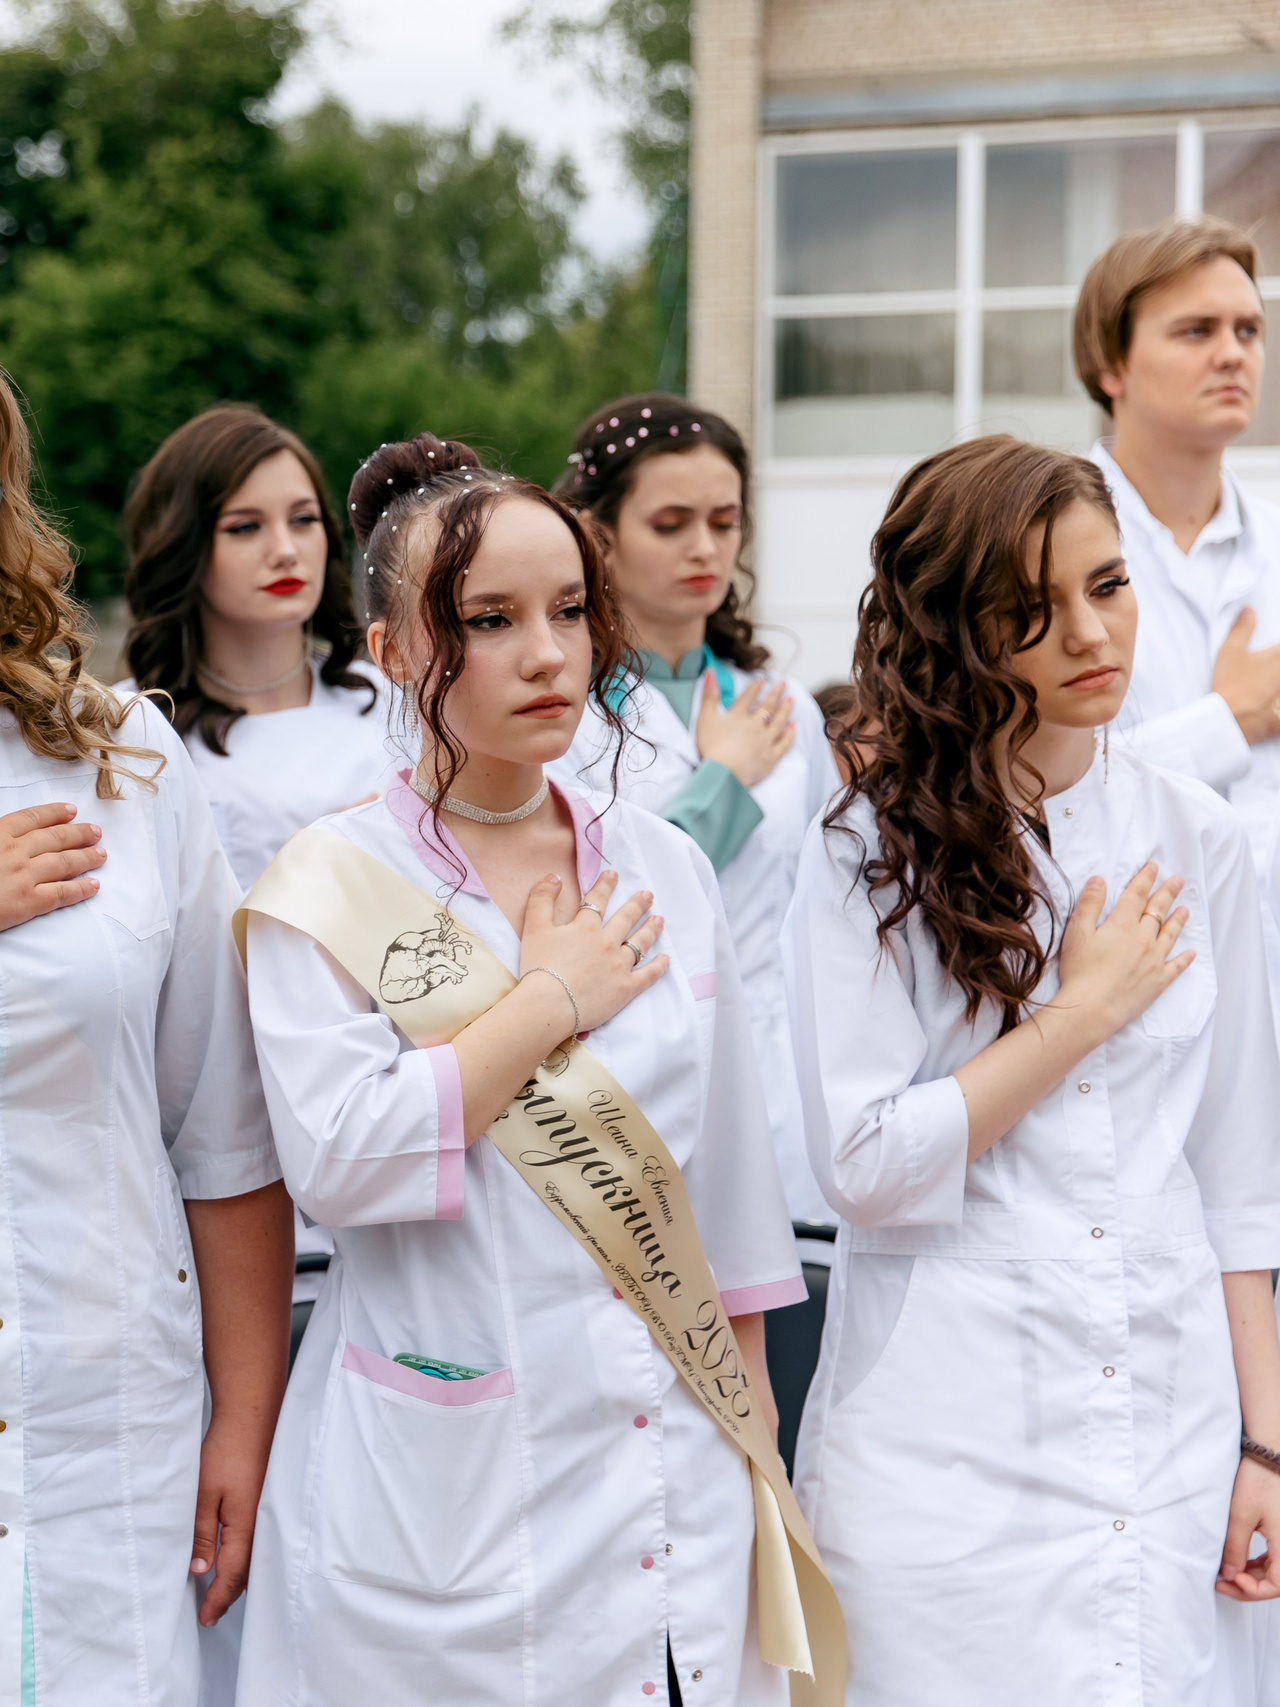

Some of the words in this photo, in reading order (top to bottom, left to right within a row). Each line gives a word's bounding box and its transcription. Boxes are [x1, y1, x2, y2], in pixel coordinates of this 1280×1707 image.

[494, 1048, 681, 1299] ыпускница
[587, 1089, 638, 1160] Шеина
[642, 1155, 673, 1226] Евгения
[544, 1181, 589, 1235] Ефремовский
[580, 1232, 612, 1264] филиал
[649, 1310, 667, 1332] ВО
